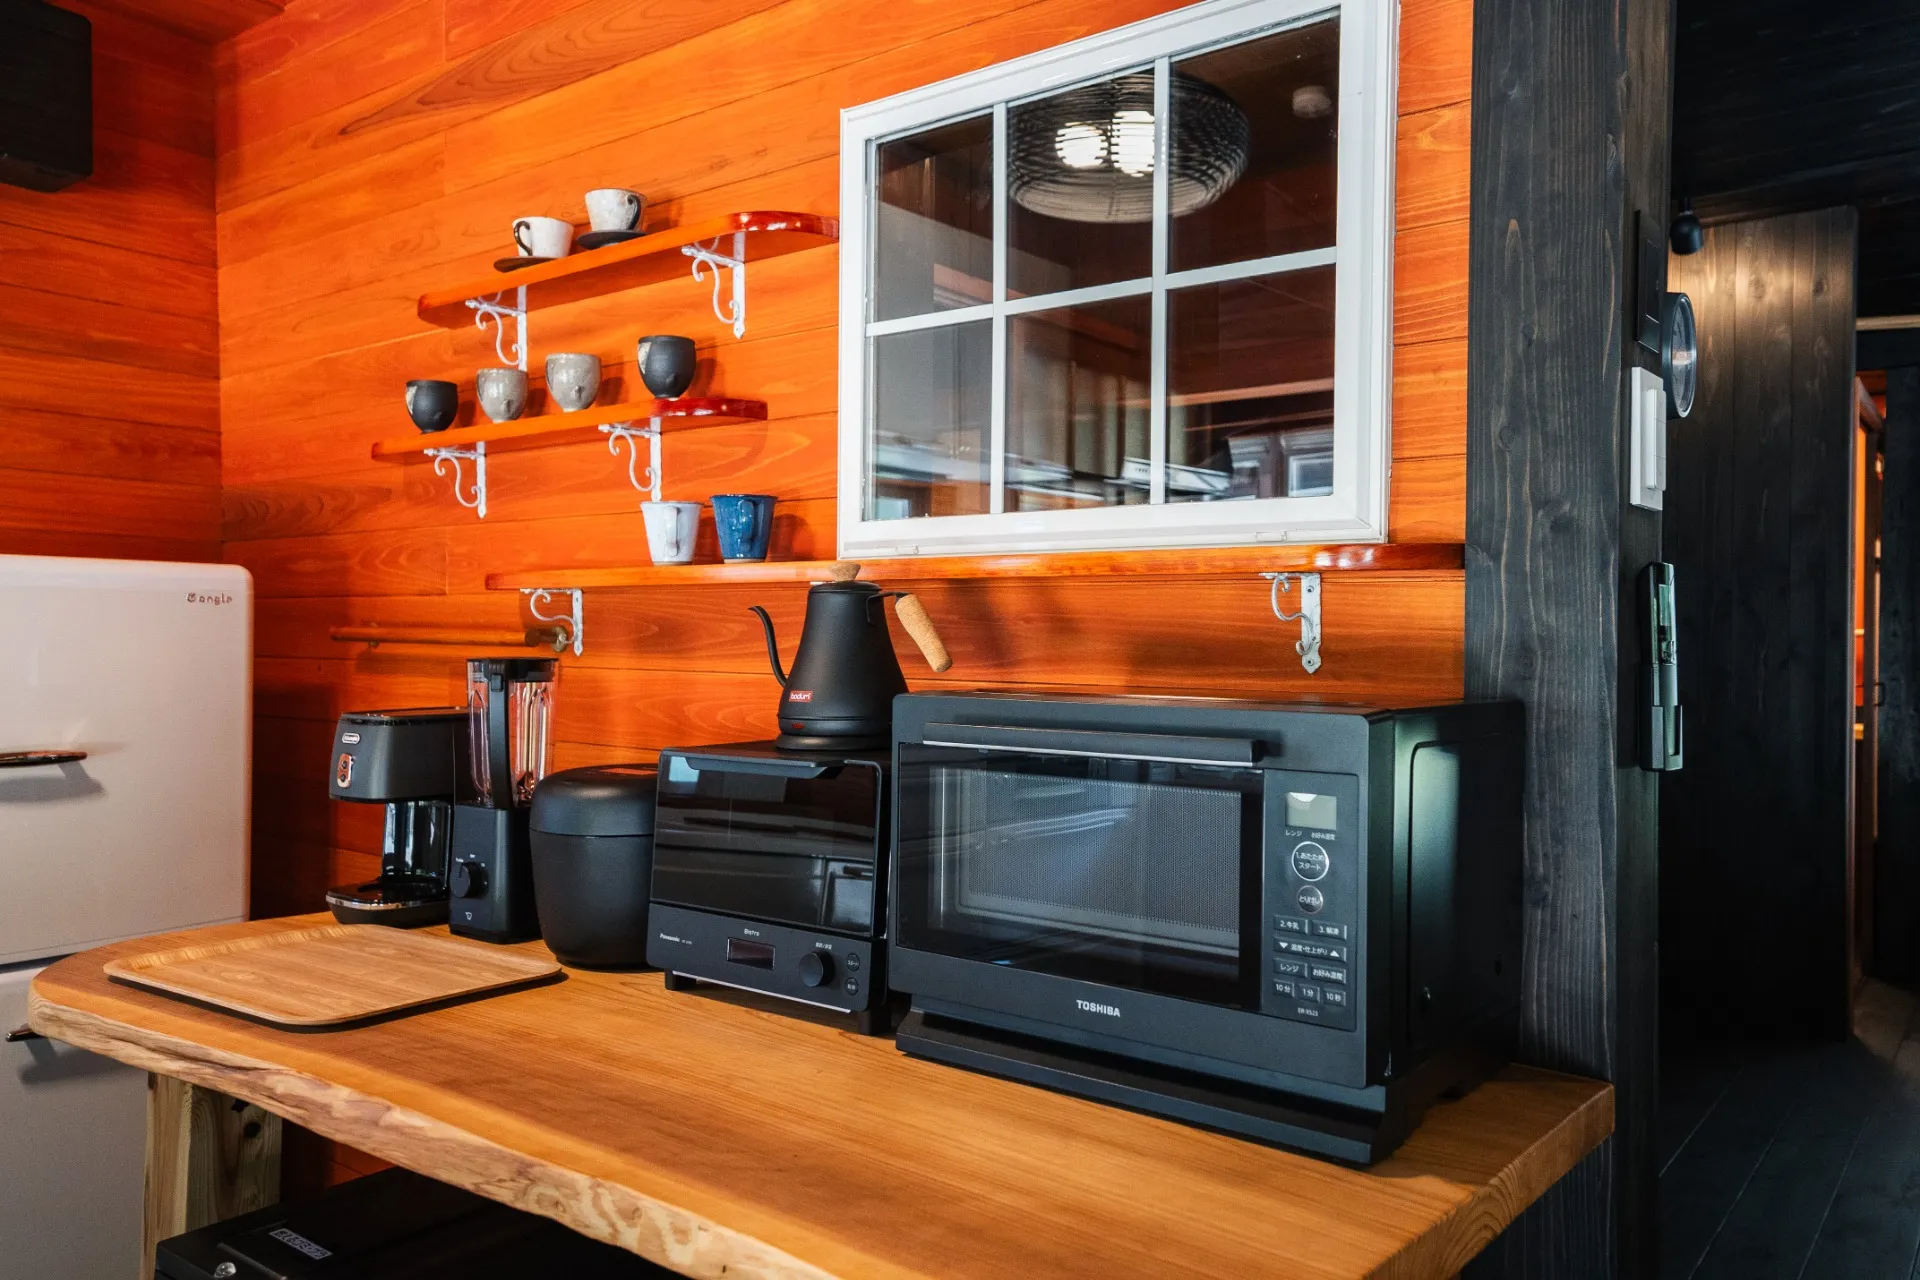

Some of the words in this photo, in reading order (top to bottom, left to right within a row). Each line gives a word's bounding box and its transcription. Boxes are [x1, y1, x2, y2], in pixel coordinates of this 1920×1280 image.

[1298, 862, 1322, 871] スタート
[1280, 963, 1299, 972] レンジ
[1076, 999, 1121, 1017] TOSHIBA
